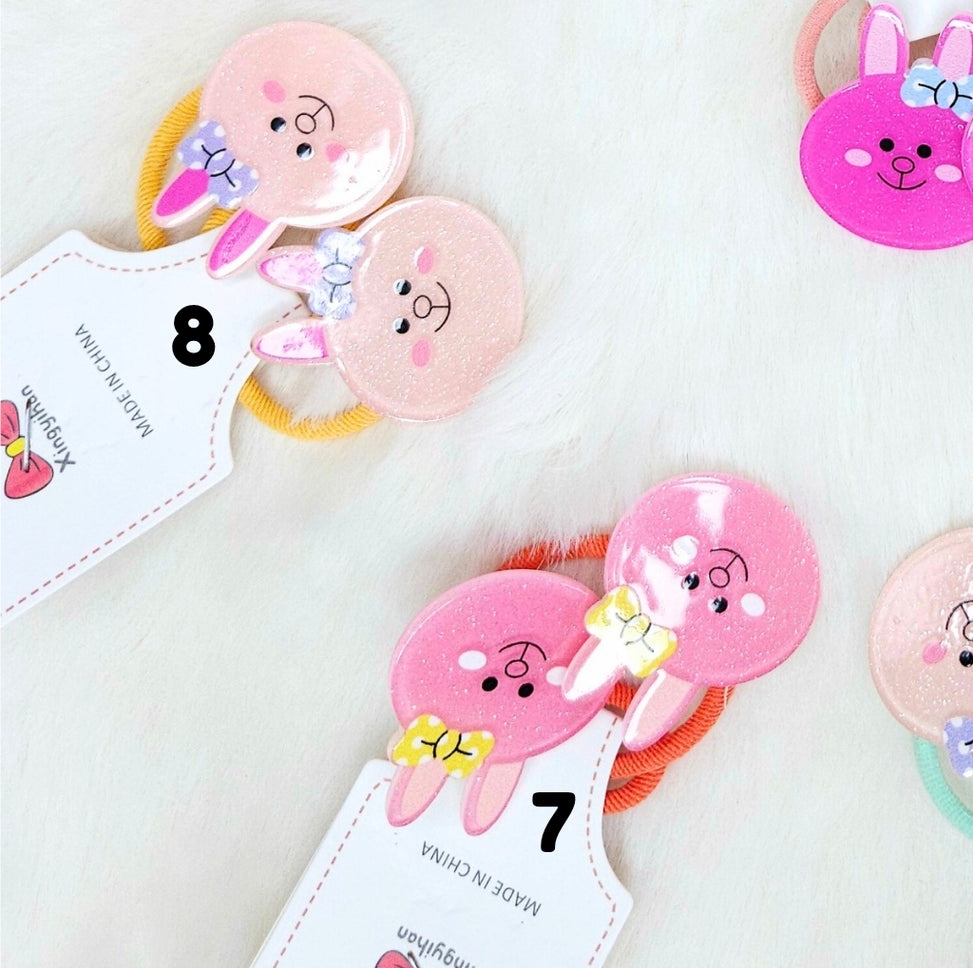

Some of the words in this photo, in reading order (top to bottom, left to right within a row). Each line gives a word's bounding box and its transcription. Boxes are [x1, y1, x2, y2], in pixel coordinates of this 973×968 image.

[75, 324, 110, 372] CHINA
[105, 373, 124, 392] IN
[117, 394, 153, 438] MADE
[422, 841, 470, 877] CHINA
[472, 870, 491, 889] IN
[491, 880, 541, 916] MADE
